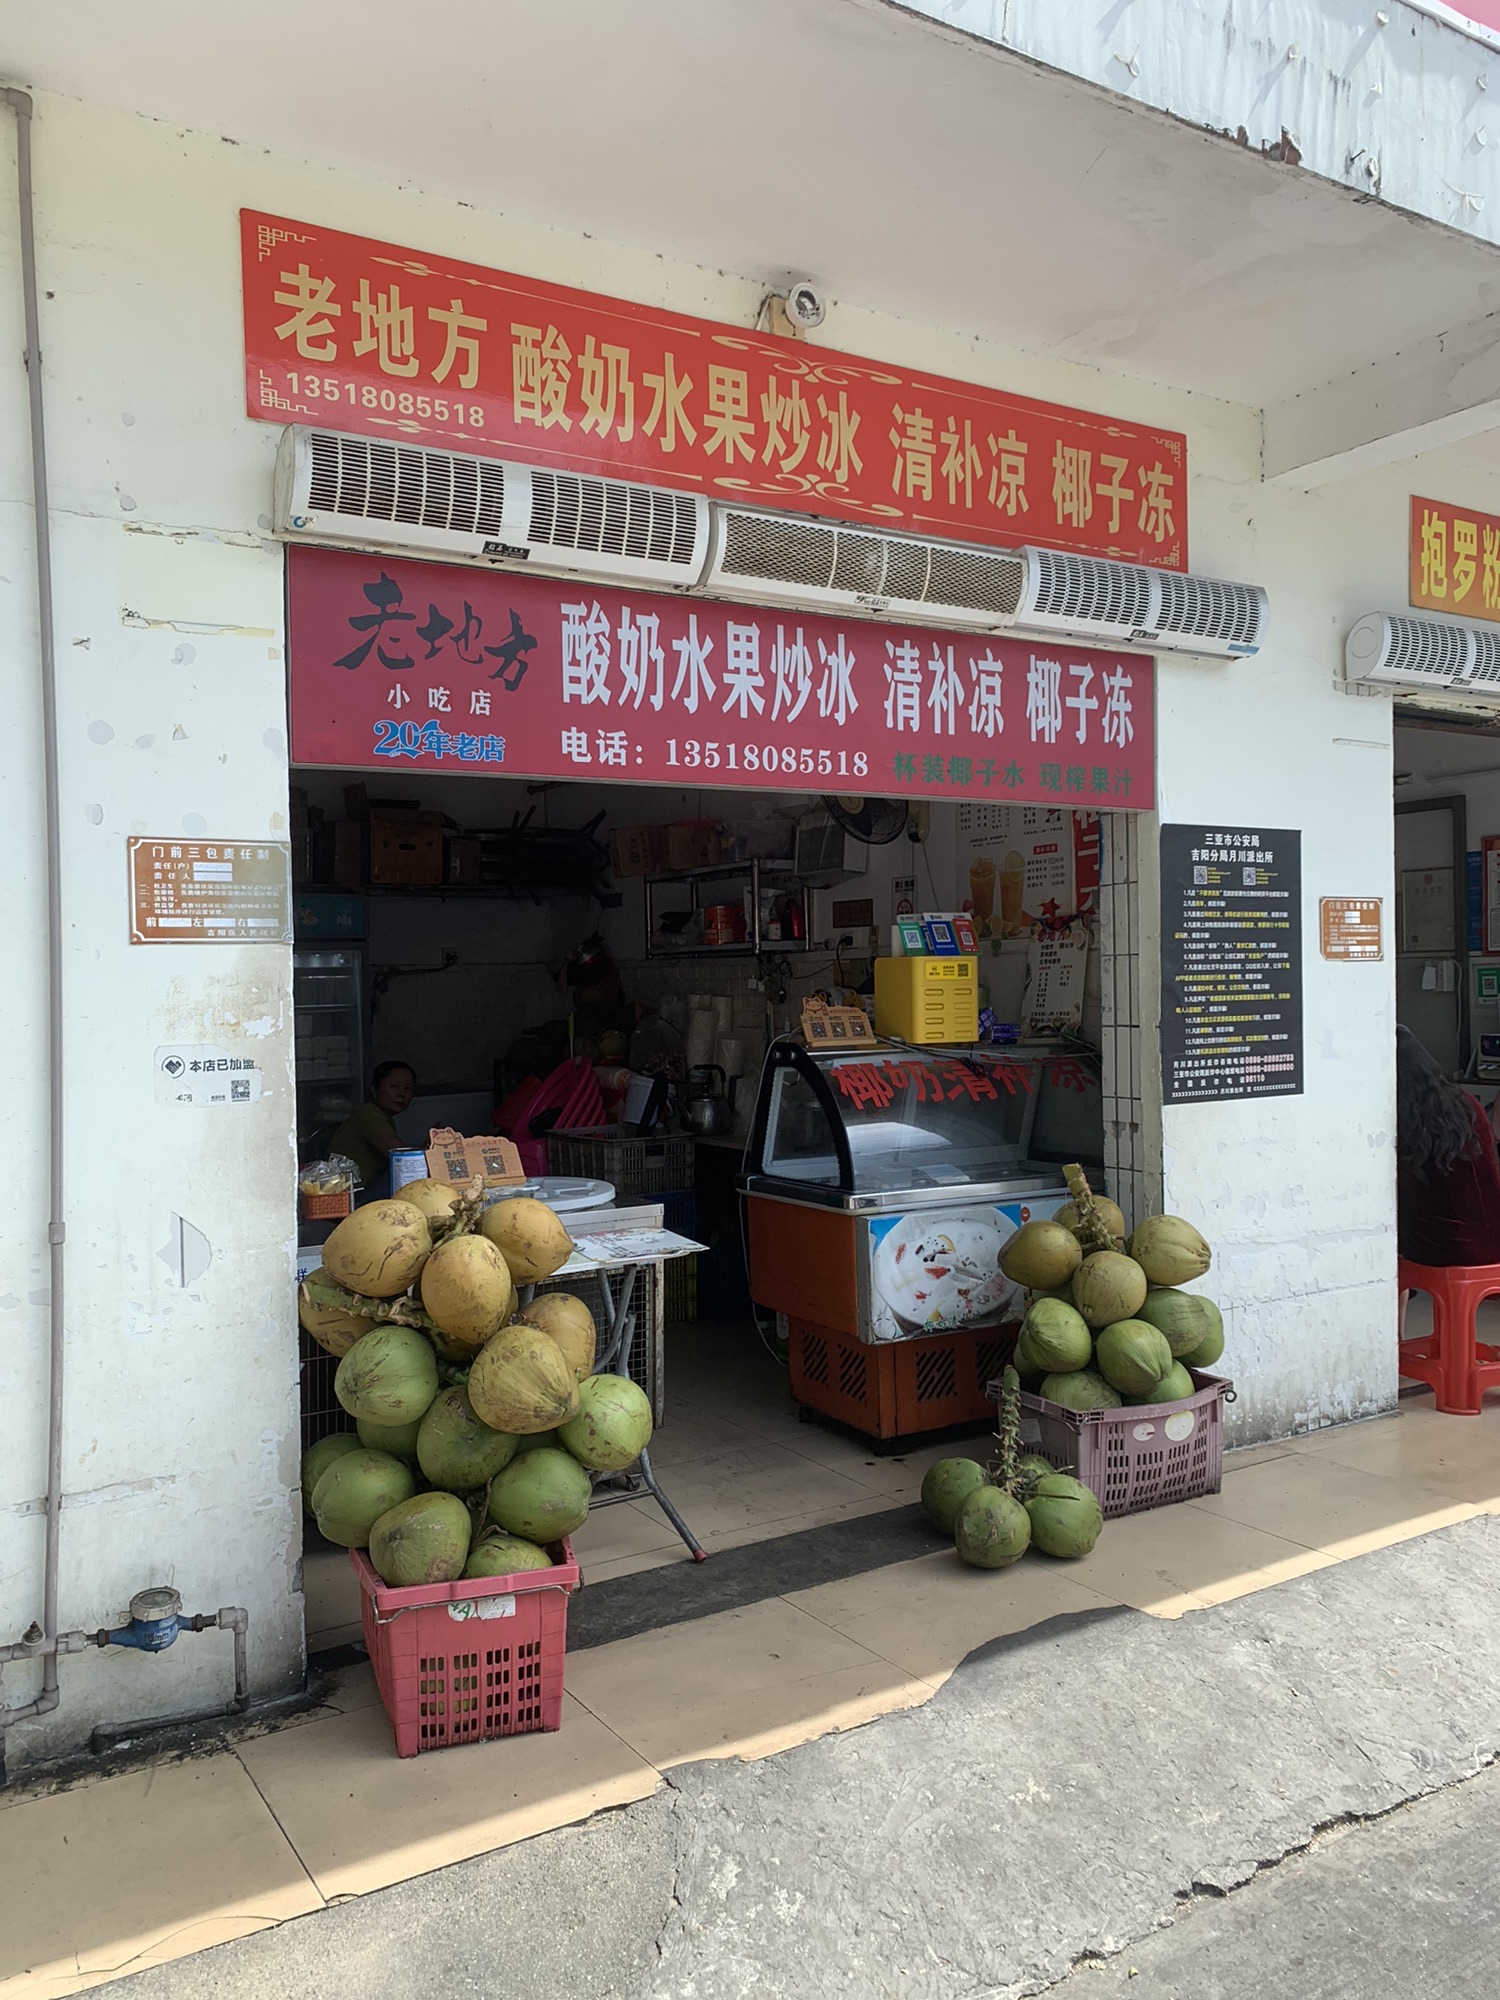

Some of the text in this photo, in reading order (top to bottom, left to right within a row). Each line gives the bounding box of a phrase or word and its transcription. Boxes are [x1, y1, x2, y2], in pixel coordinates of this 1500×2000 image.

[274, 263, 1175, 543] 老地方 酸奶水果炒冰 清补凉 椰子冻
[286, 372, 485, 427] 13518085518
[332, 571, 538, 691] 老地方
[561, 600, 1134, 748] 酸奶水果炒冰 清补凉 椰子冻
[387, 683, 492, 716] 小吃店
[373, 719, 505, 762] 20年老店
[561, 726, 869, 777] 电话： 13518085518
[893, 751, 1133, 797] 杯装椰子水 现榨果汁
[152, 845, 269, 861] 门前三包责任制
[1191, 848, 1273, 863] 吉阳分局月川派出所
[1205, 833, 1260, 848] 三亚市公安局
[153, 871, 191, 880] 责任人
[146, 917, 247, 928] 前 左 右
[189, 1058, 256, 1073] 本店已加盟
[831, 1055, 1097, 1110] 椰奶清补凉
